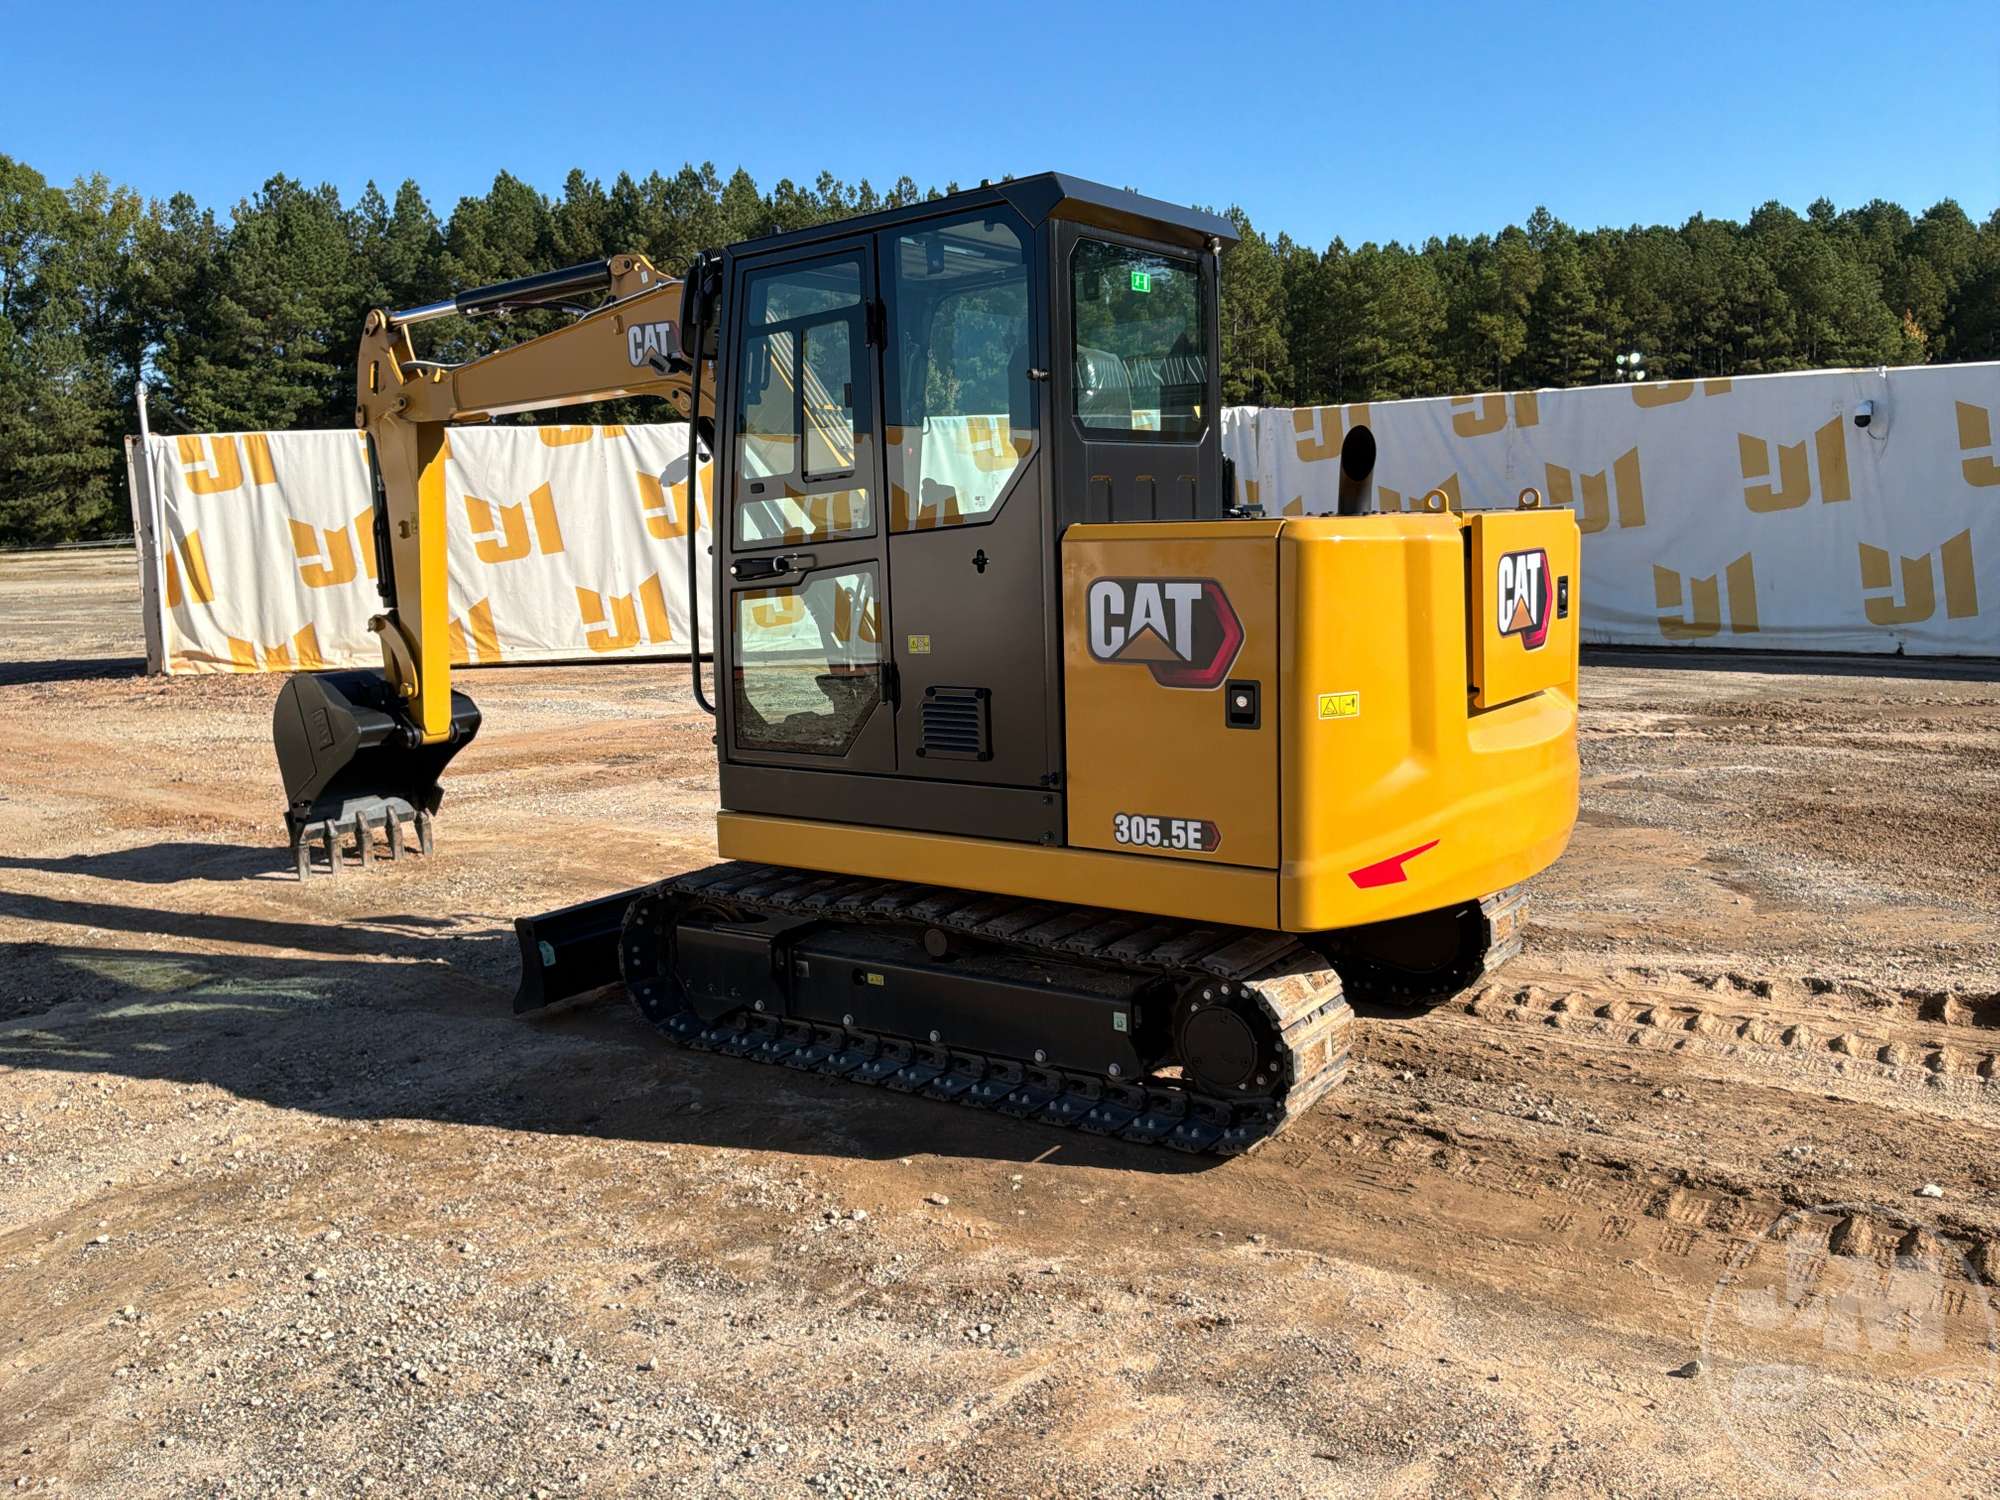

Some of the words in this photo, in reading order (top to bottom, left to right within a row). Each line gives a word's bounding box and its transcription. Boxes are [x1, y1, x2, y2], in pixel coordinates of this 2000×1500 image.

[628, 322, 670, 367] CAT
[1089, 580, 1202, 662] CAT
[1498, 551, 1542, 634] CAT
[1114, 814, 1203, 850] 305.5E
